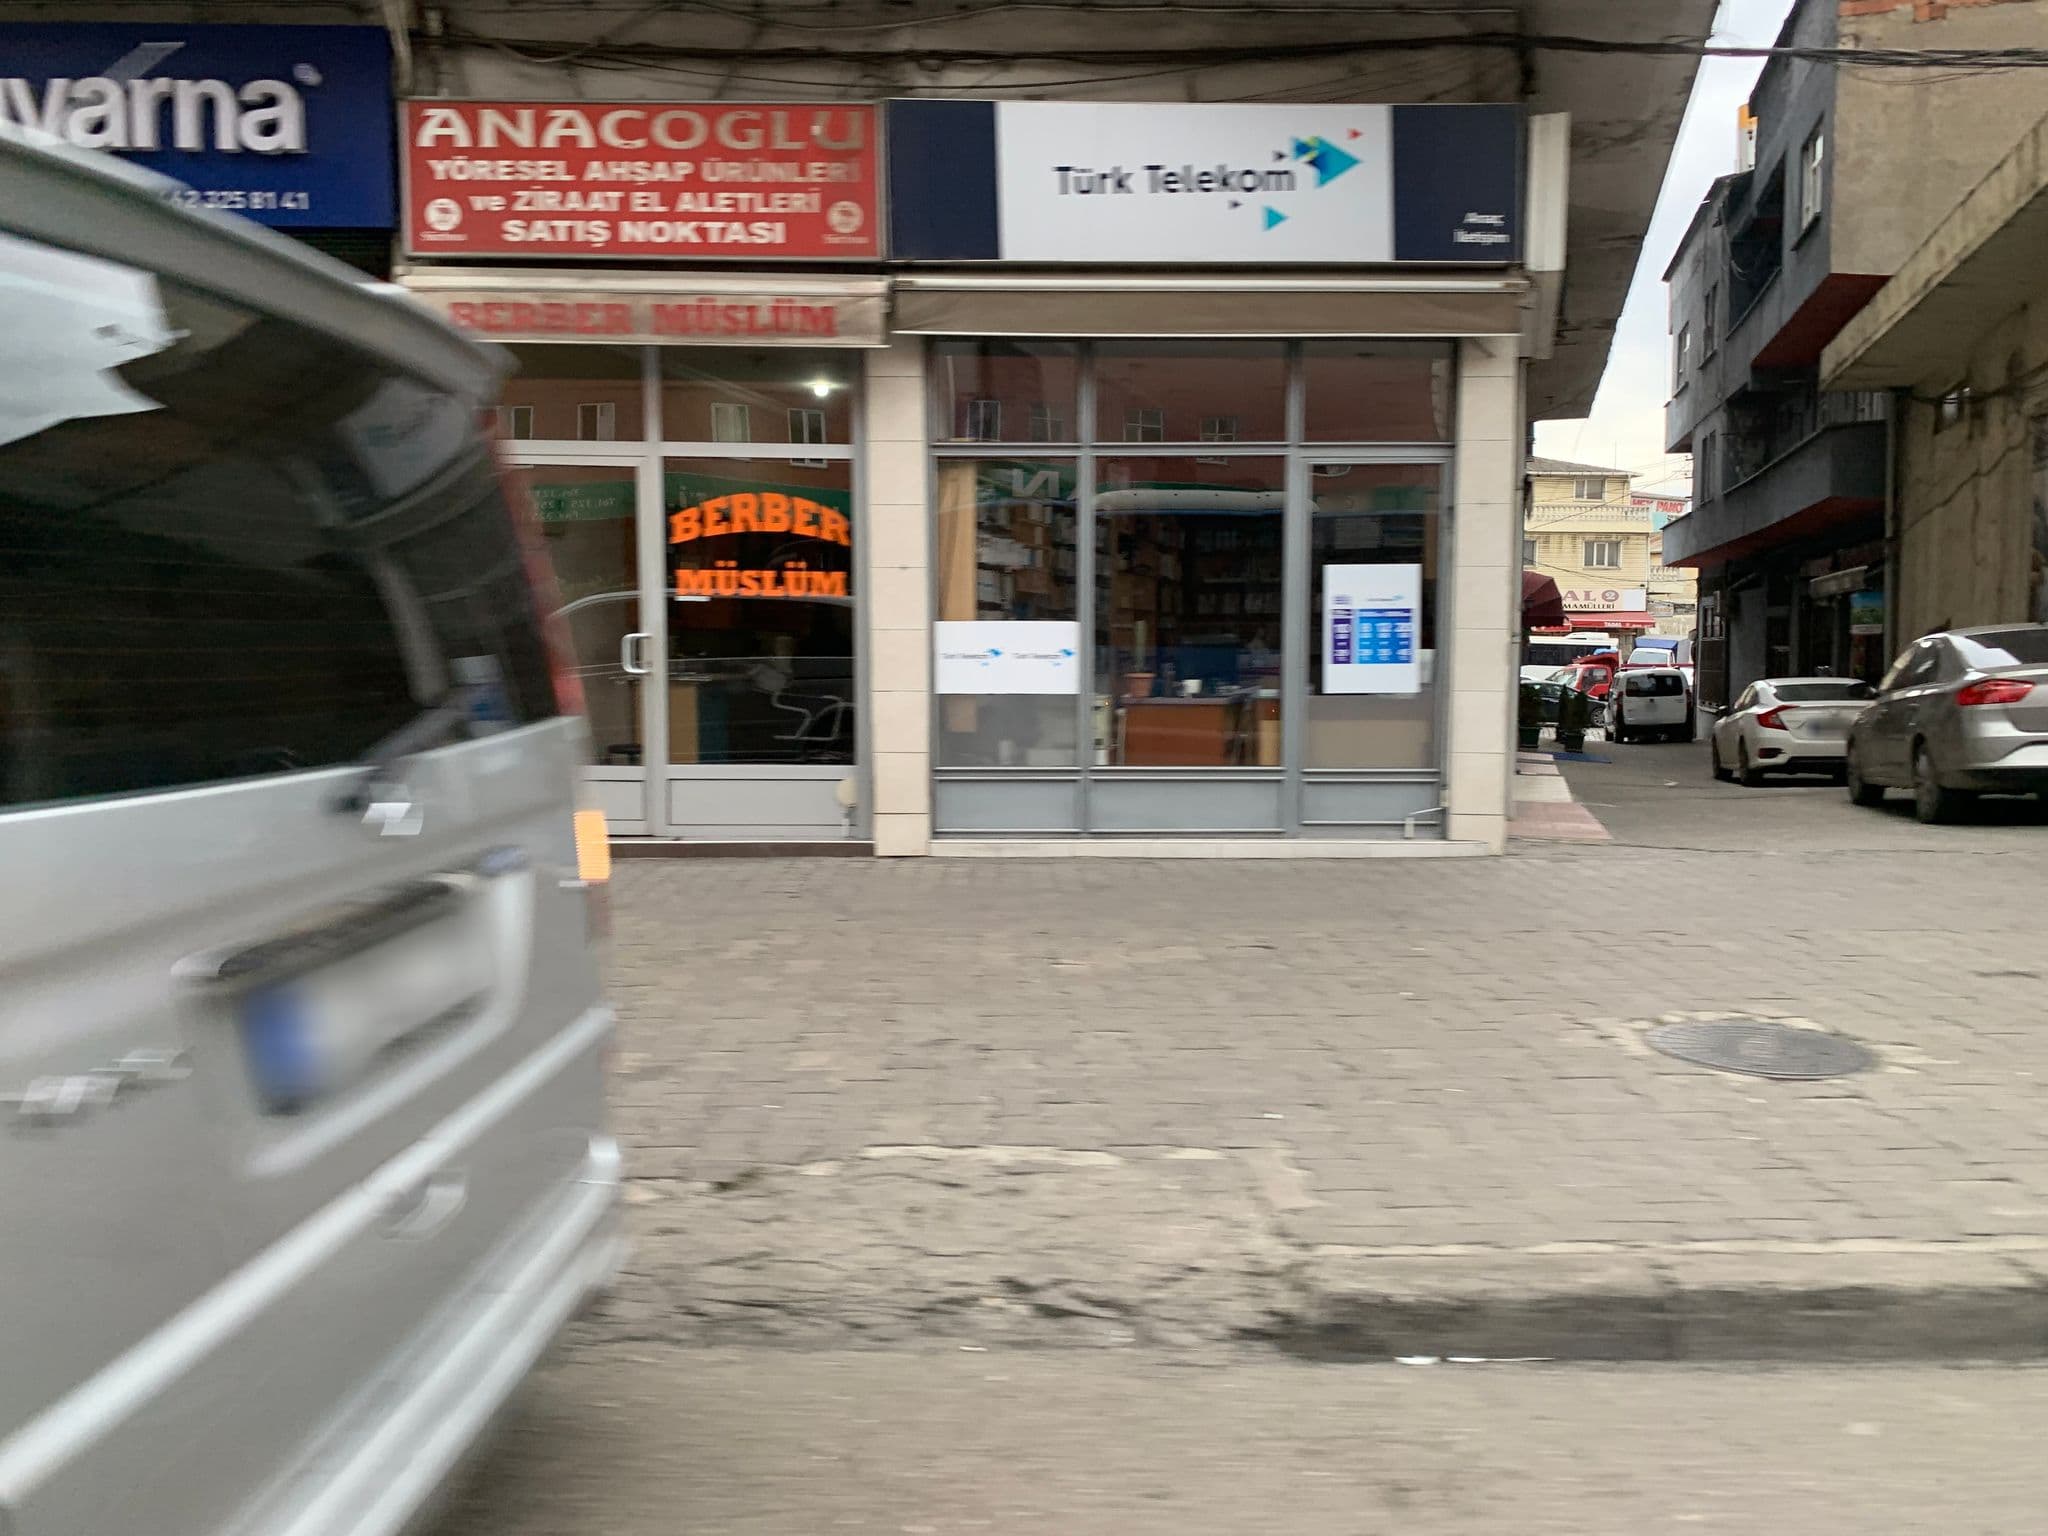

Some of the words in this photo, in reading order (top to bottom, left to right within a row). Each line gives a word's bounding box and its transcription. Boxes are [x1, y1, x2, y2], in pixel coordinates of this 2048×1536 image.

[0, 77, 308, 154] varna
[427, 155, 576, 181] YÖRESEL
[1052, 165, 1134, 195] Türk
[1143, 164, 1297, 194] Telekom
[468, 196, 507, 211] ve
[629, 191, 669, 212] EL
[501, 219, 612, 247] SATIŞ
[618, 220, 787, 244] NOKTASI
[449, 302, 634, 334] BERBER
[651, 297, 838, 337] MÜSLÜM
[669, 492, 853, 546] BERBER
[675, 560, 847, 597] MÜSLÜM
